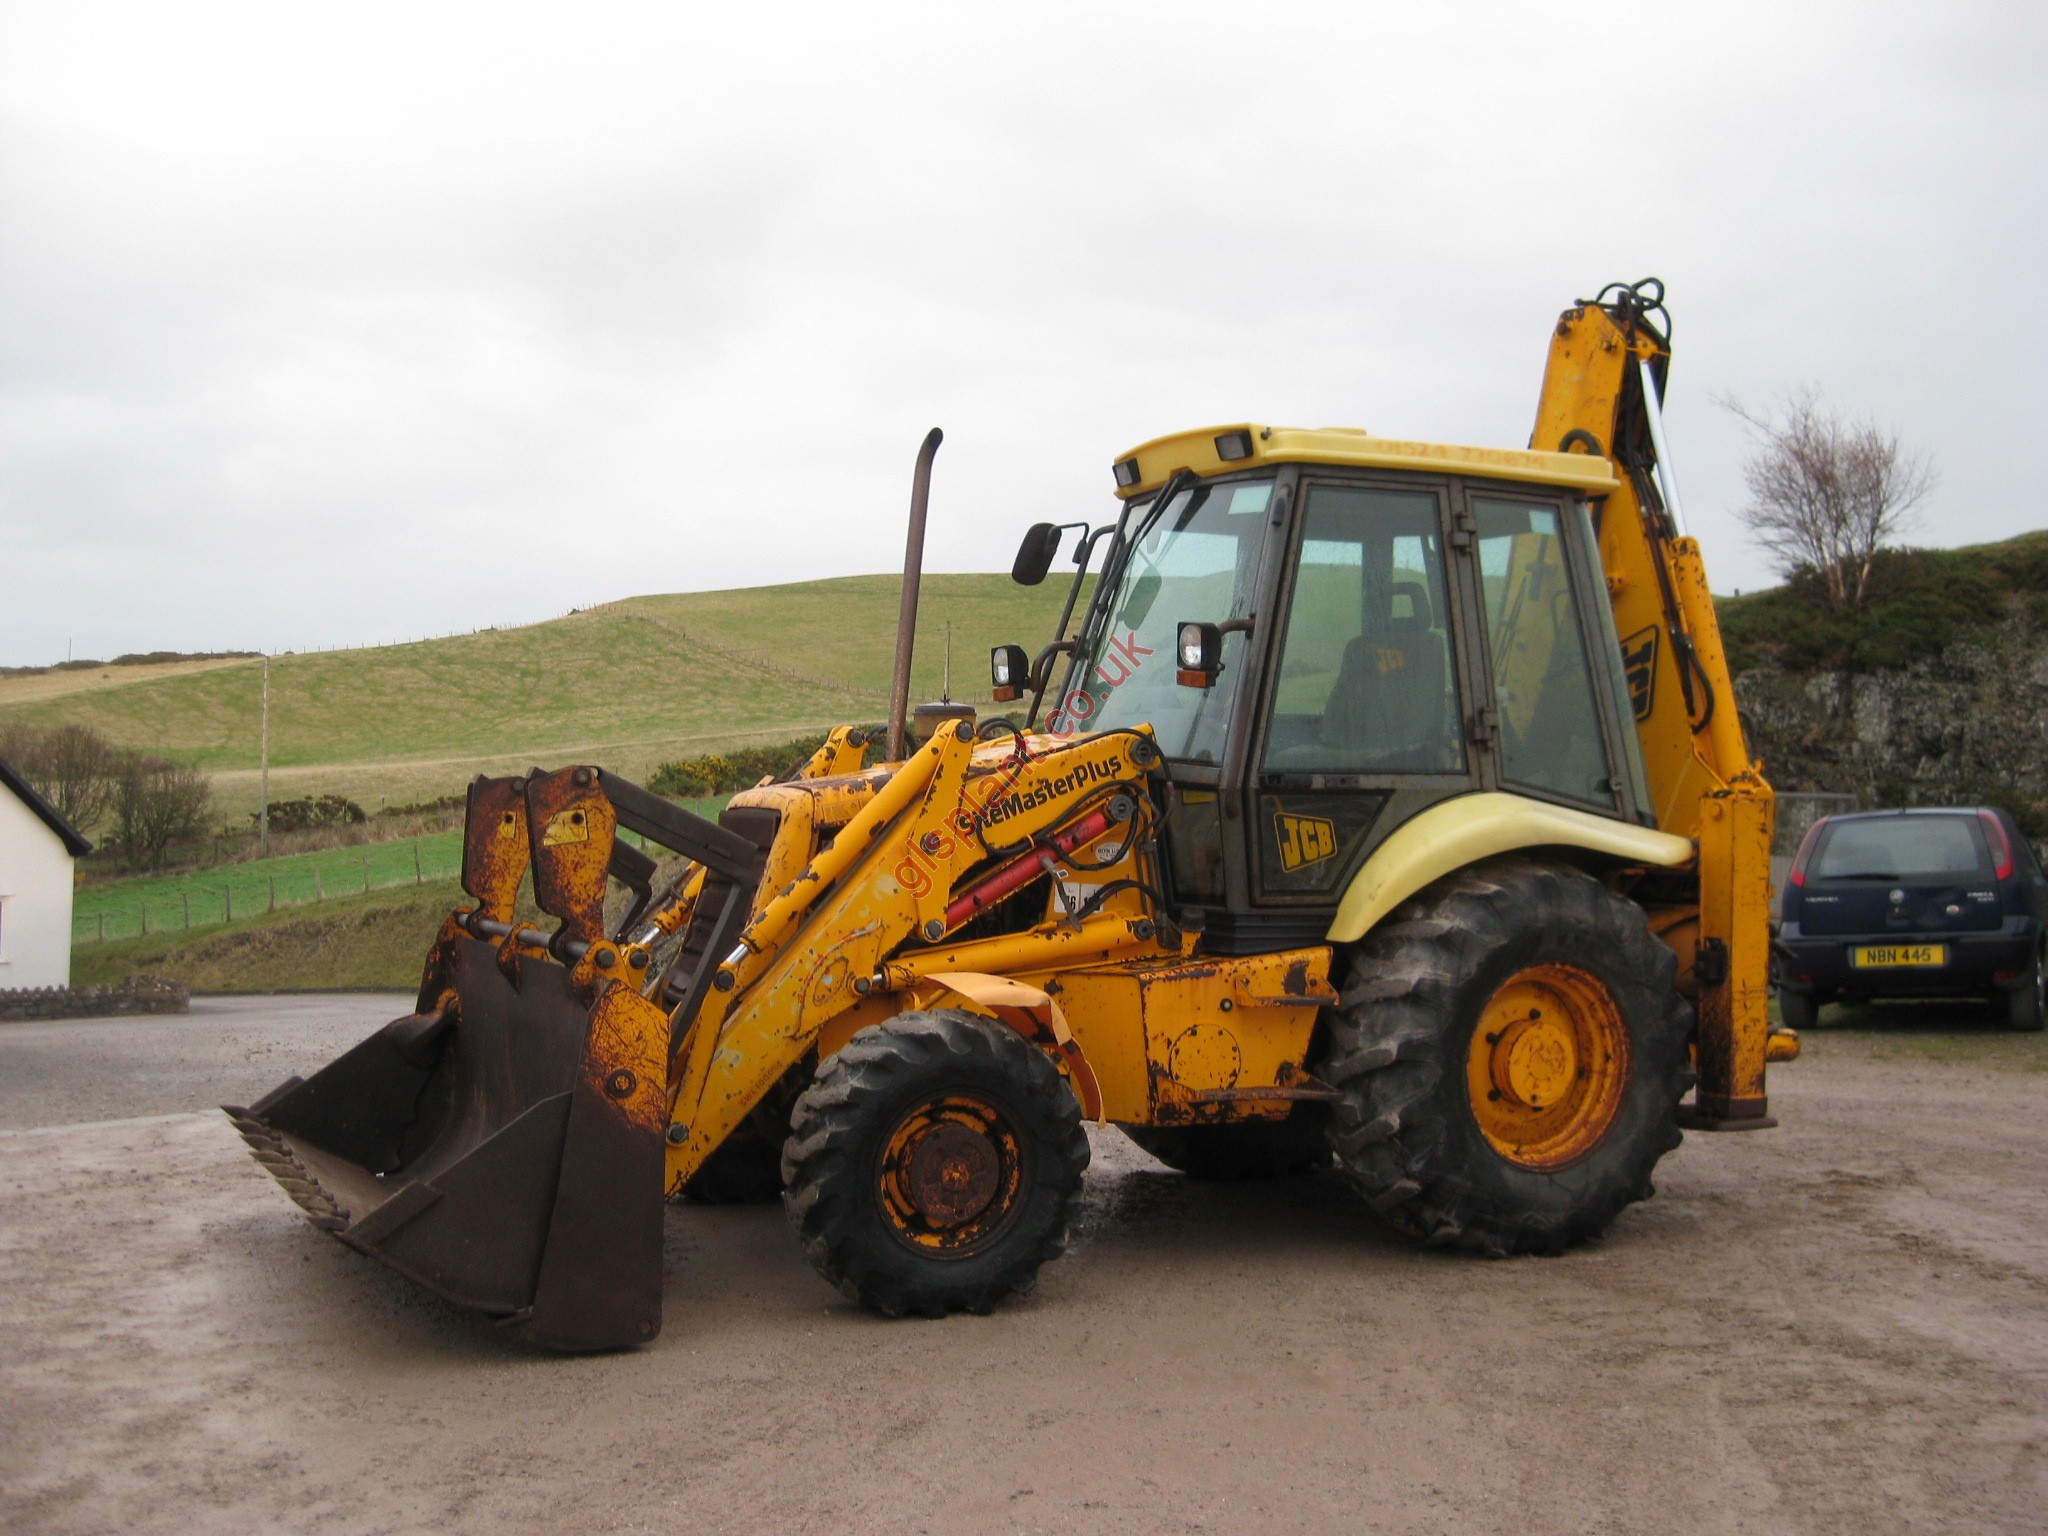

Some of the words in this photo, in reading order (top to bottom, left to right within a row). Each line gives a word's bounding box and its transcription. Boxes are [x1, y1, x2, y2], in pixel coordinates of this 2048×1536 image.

[1283, 817, 1334, 868] JCB
[1866, 949, 1897, 964] NBN
[1901, 948, 1932, 963] 445
